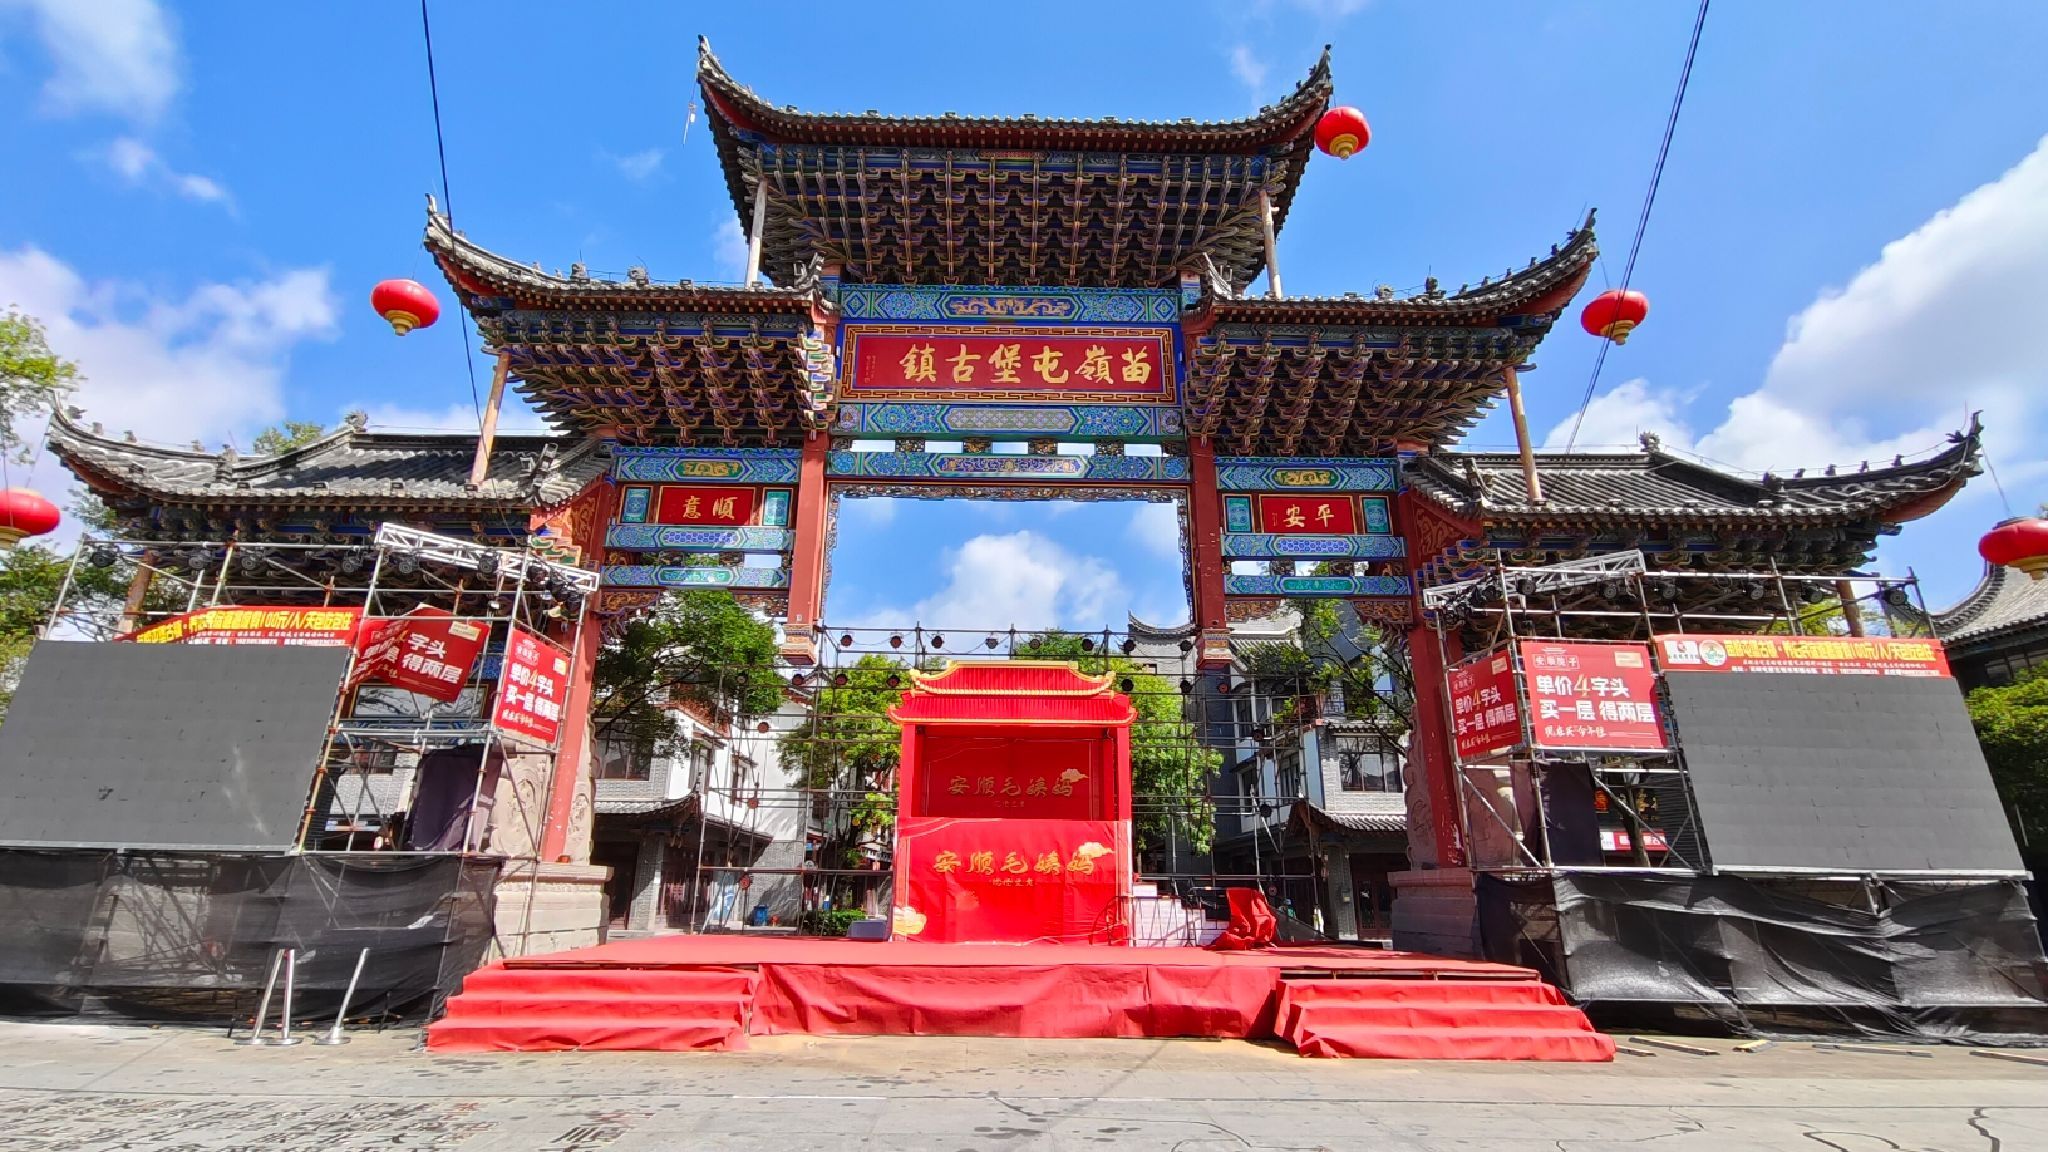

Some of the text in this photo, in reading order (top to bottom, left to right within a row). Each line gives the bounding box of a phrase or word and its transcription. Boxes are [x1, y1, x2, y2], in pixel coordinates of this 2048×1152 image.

[1535, 673, 1630, 698] 单价4字头
[1539, 699, 1655, 723] 买一层 得两层
